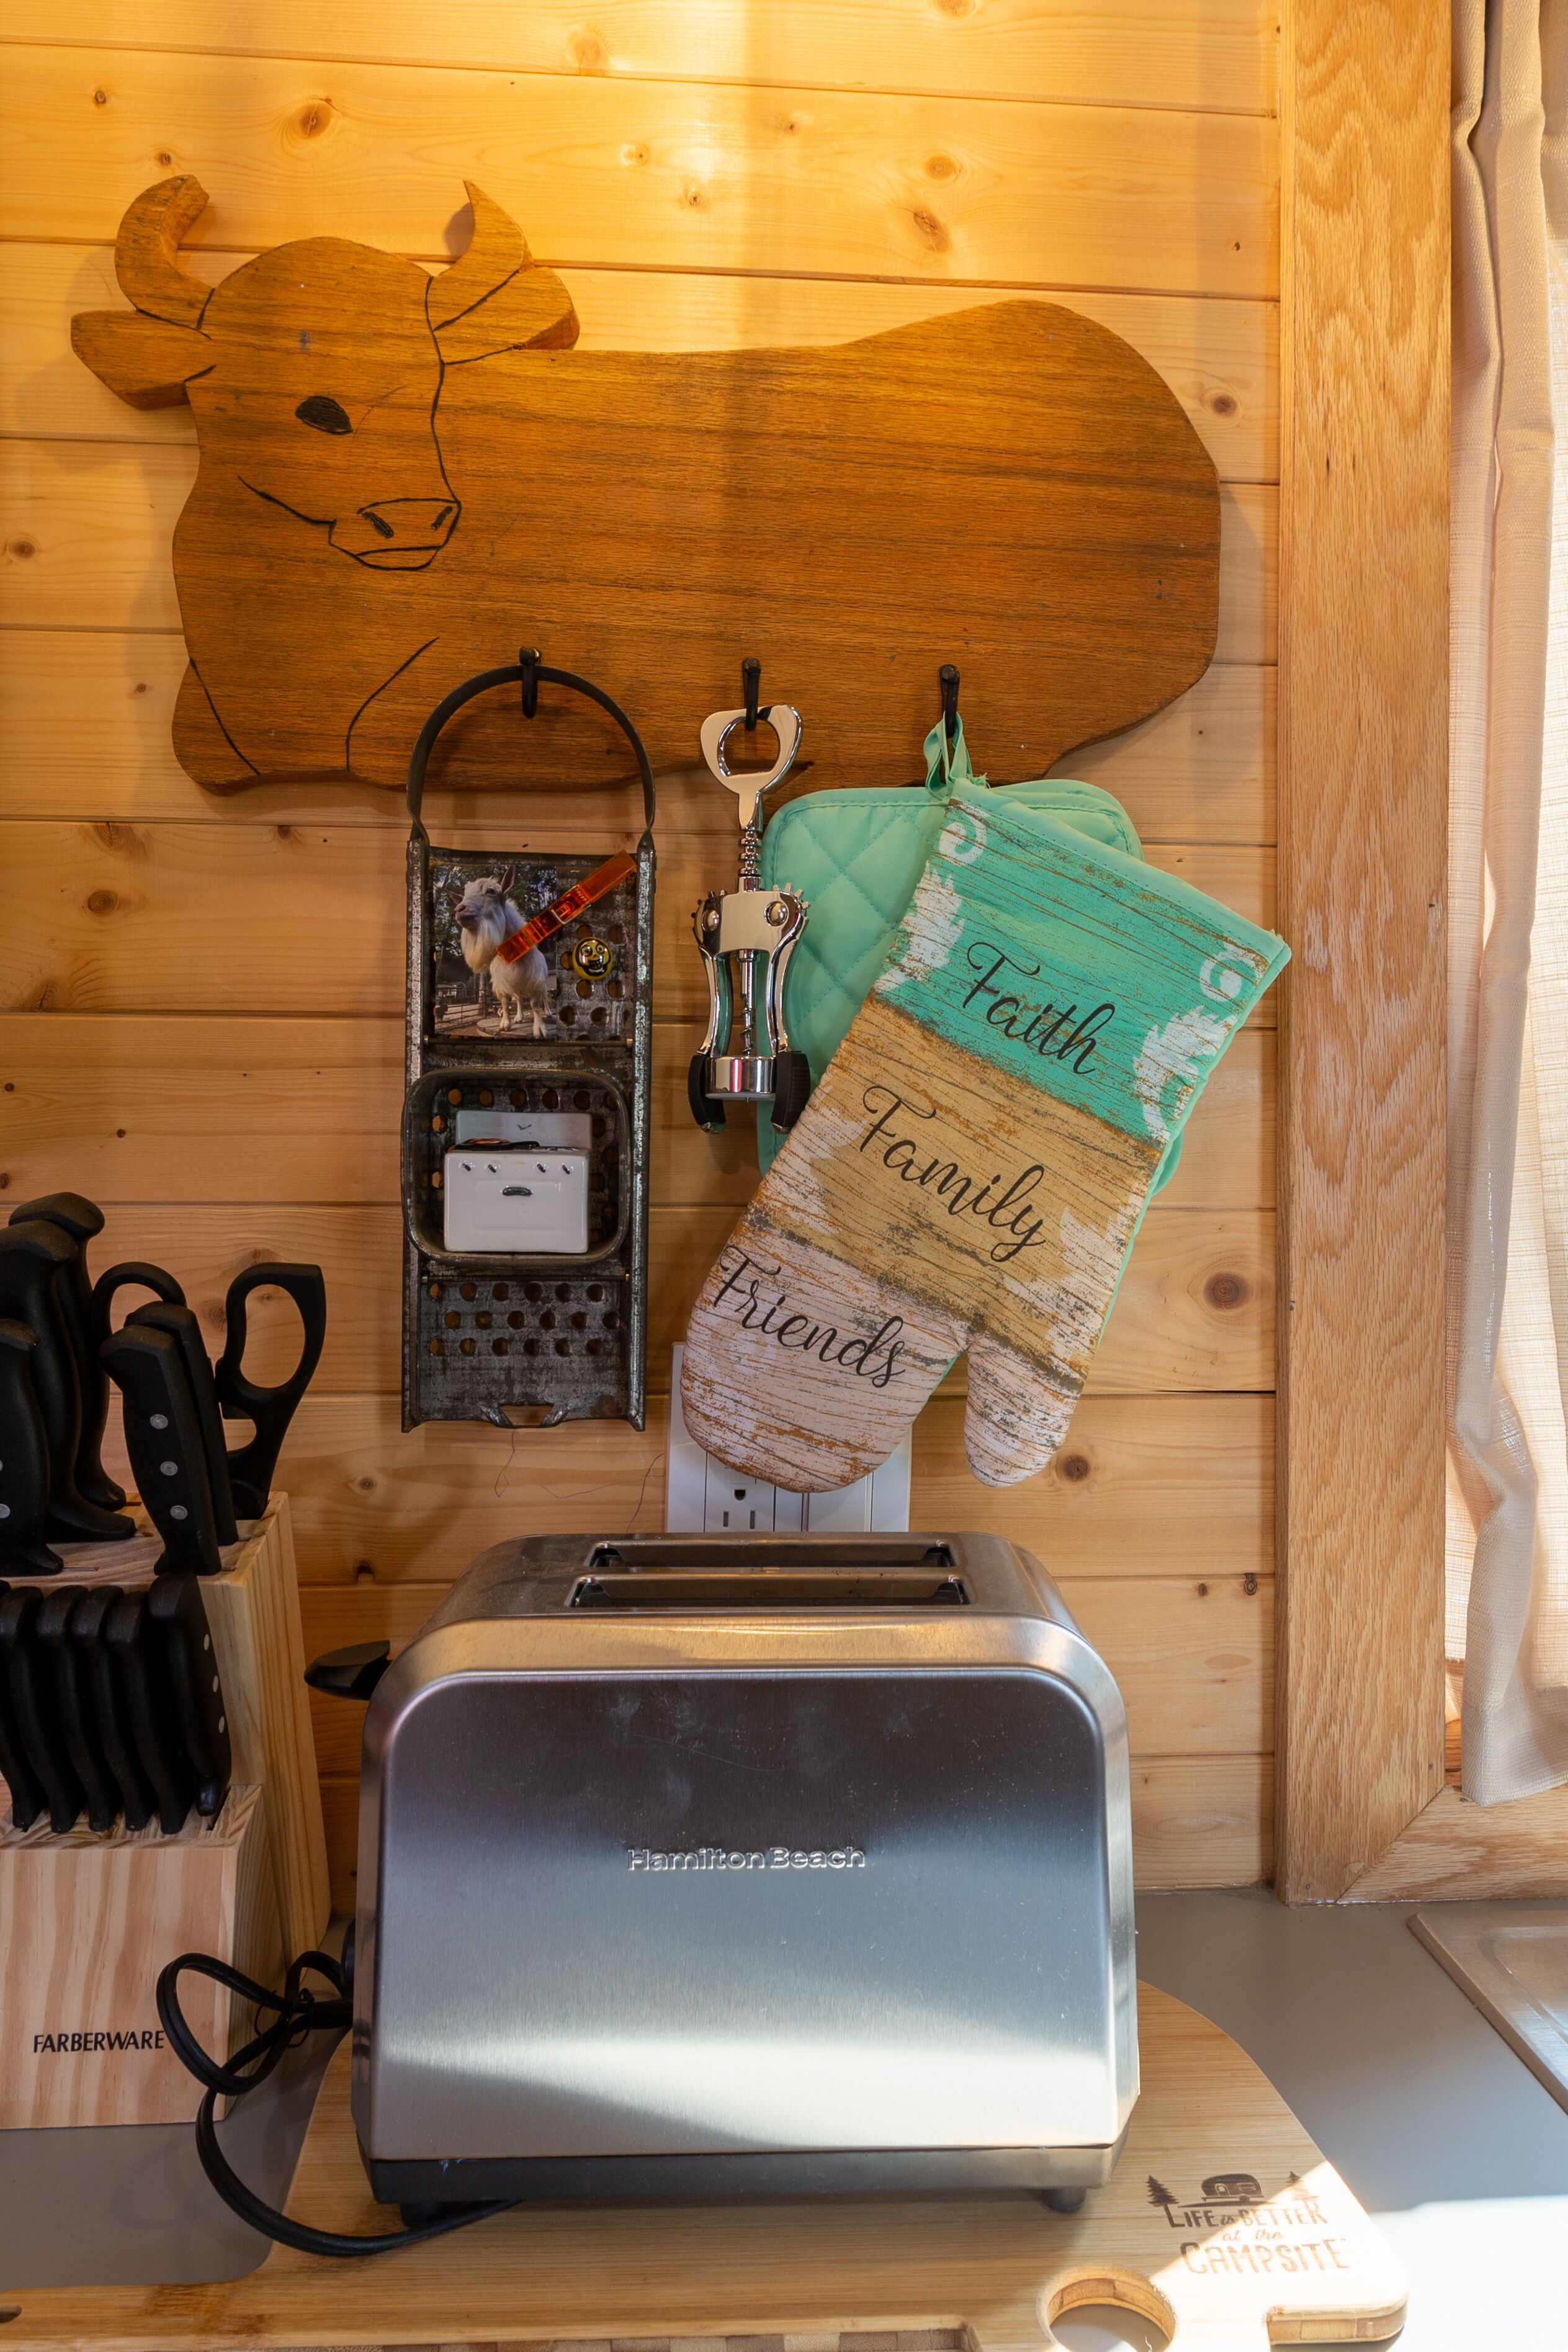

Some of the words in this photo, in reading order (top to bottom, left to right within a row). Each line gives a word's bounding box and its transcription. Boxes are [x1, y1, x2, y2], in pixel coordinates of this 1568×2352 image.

[962, 940, 1115, 1075] Faith
[859, 1084, 1046, 1262] Family
[712, 1245, 907, 1388] Friends
[627, 1846, 765, 1870] Hamilton
[769, 1846, 866, 1869] Beach
[33, 2030, 165, 2054] FARBERWARE
[1163, 2204, 1219, 2228] LIFE
[1220, 2214, 1236, 2227] is
[1238, 2199, 1328, 2226] BETTER
[1222, 2229, 1241, 2242] at
[1255, 2228, 1284, 2241] the
[1180, 2238, 1350, 2274] CAMPSITE
